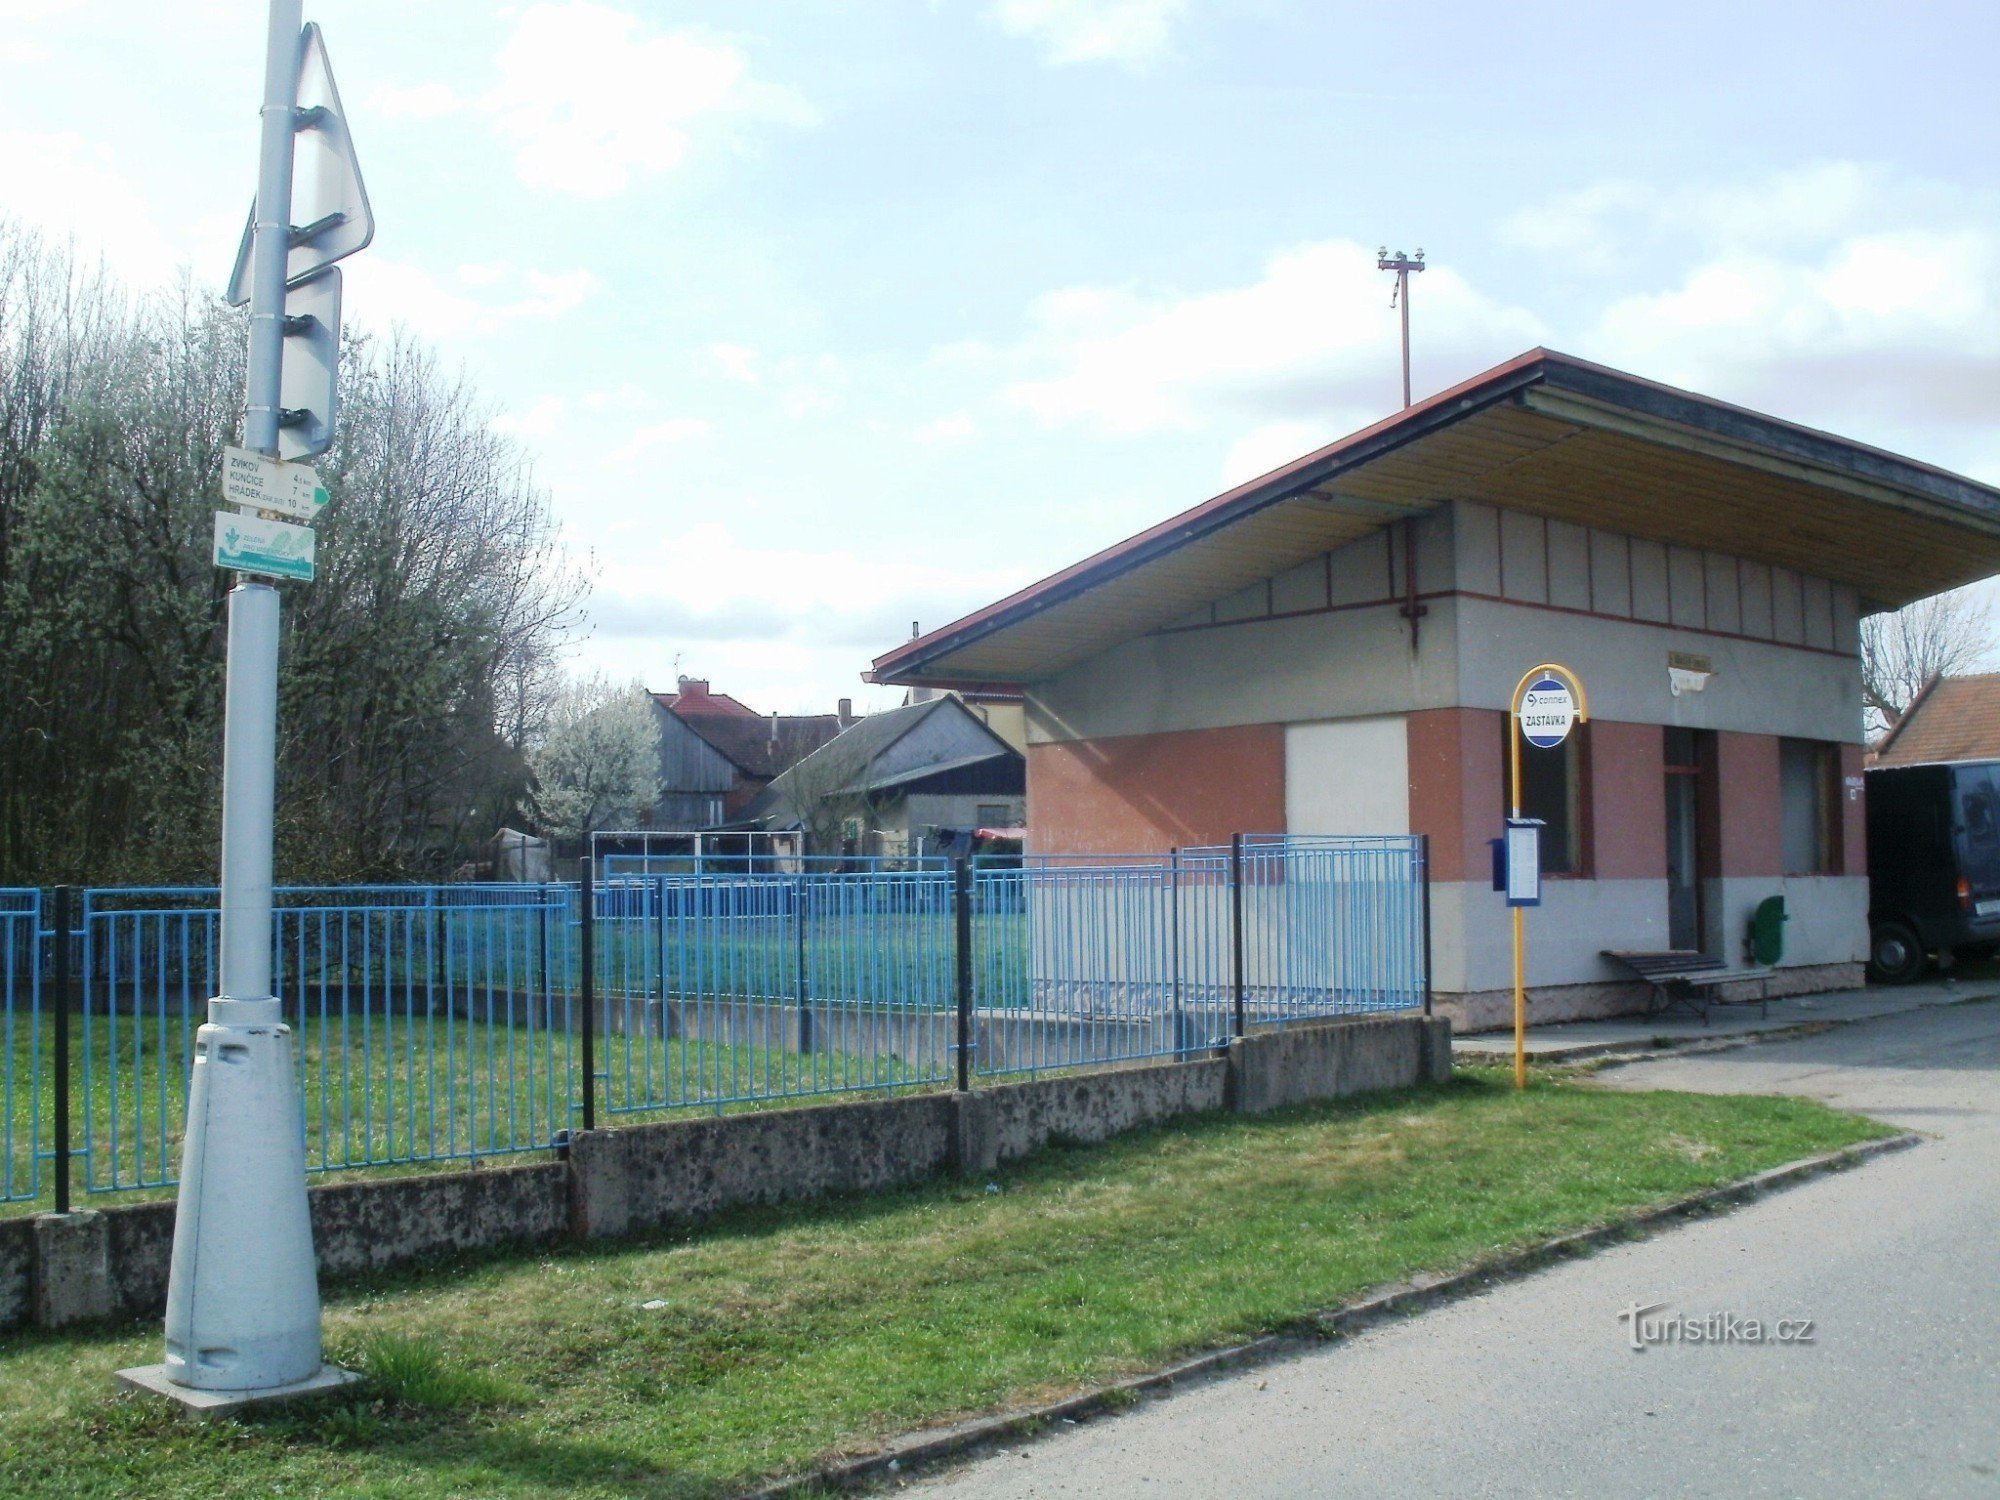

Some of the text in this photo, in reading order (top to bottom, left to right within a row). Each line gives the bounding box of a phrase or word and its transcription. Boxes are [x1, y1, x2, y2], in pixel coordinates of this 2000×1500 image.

[229, 471, 264, 487] KUNČICE
[292, 486, 298, 495] 7
[288, 499, 297, 509] 10
[1526, 714, 1566, 727] ZASTÁVKA
